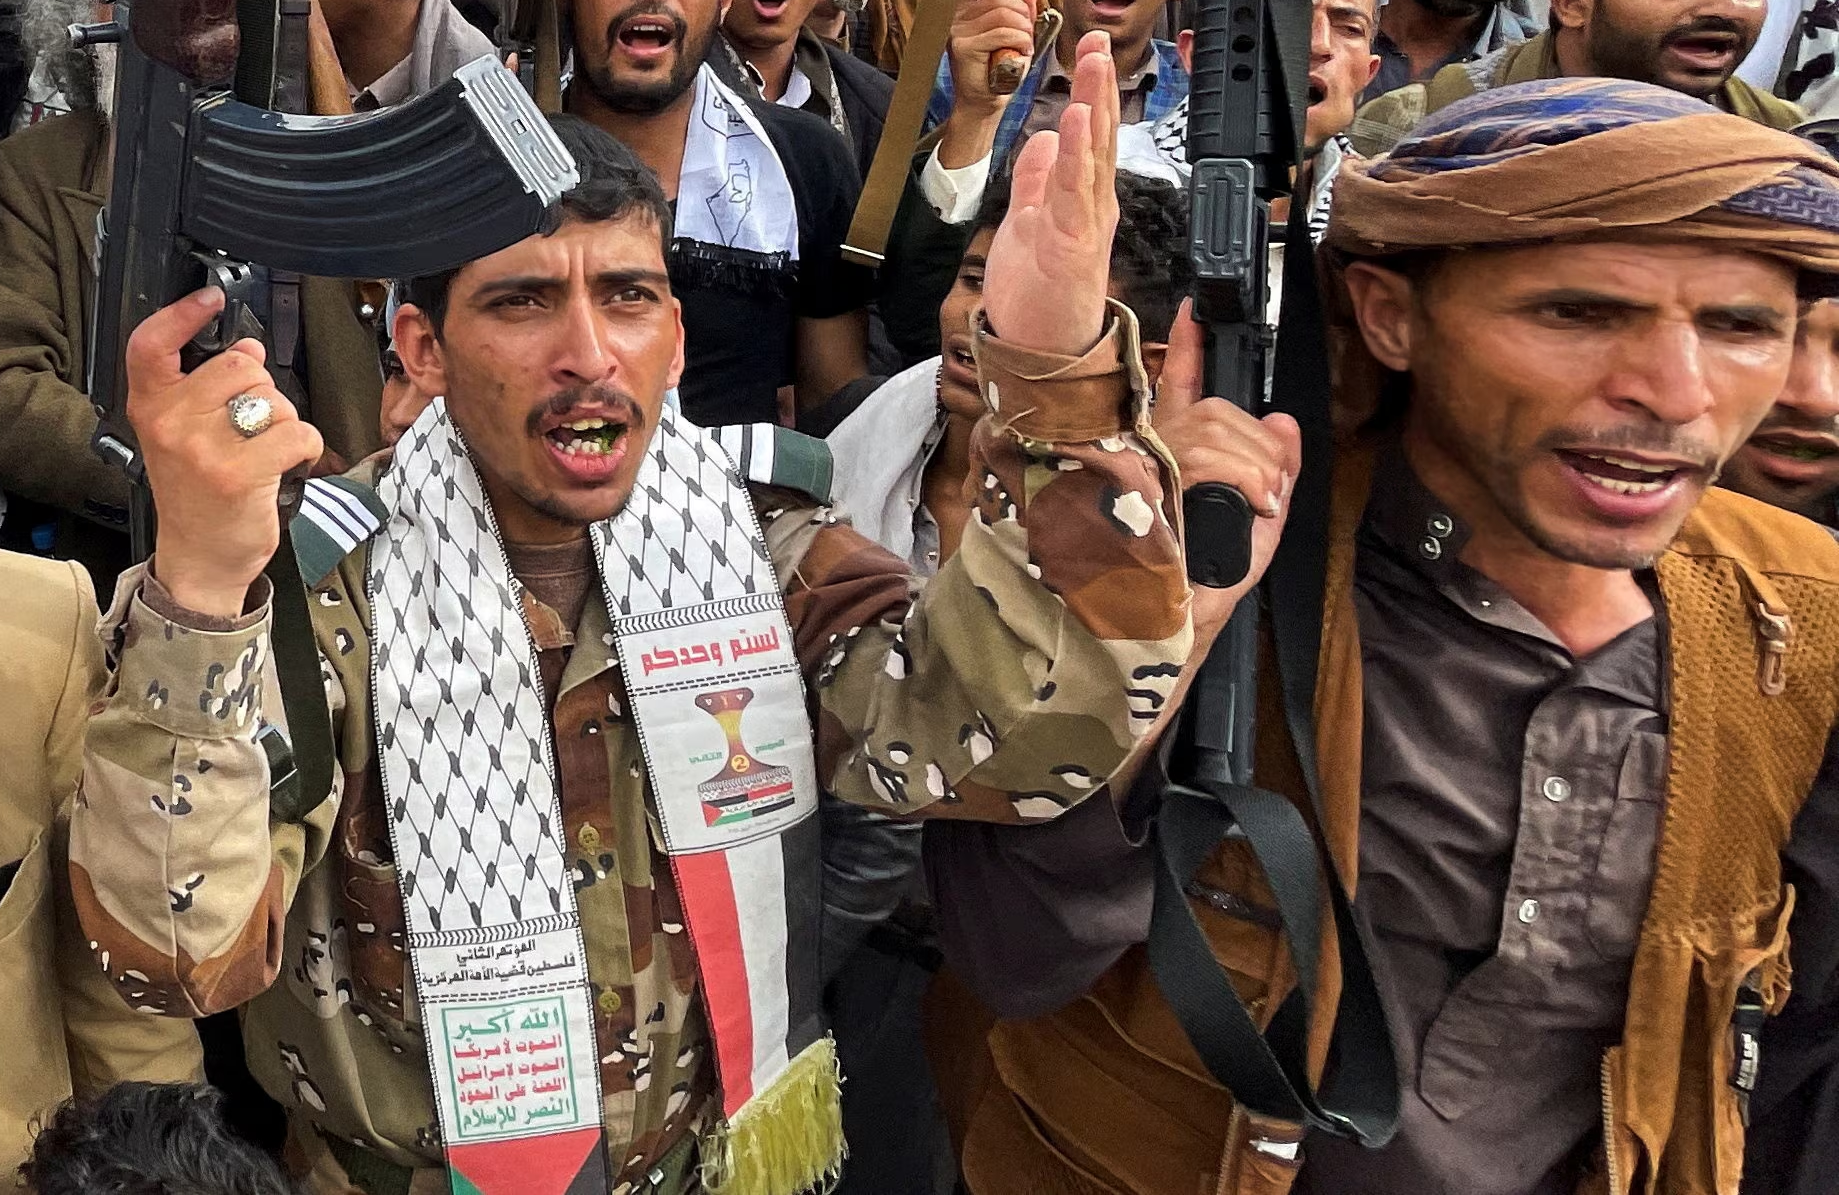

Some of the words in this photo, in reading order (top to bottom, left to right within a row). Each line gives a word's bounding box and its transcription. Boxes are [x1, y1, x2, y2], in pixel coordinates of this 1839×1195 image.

[730, 625, 780, 662] لستم
[640, 641, 724, 677] وحدكم
[734, 757, 747, 770] 2
[456, 946, 494, 967] الثاني
[495, 939, 536, 960] المؤتمر
[469, 966, 494, 981] الأمة
[495, 960, 526, 982] قضية
[526, 953, 576, 976] فلسطين
[422, 969, 469, 987] المركزية
[452, 1007, 514, 1042] أكبر
[520, 1006, 560, 1029] الله
[454, 1036, 512, 1060] لأمريكا
[516, 1033, 562, 1054] الموت
[518, 1056, 565, 1076] الموت
[459, 1085, 500, 1105] اليهود
[505, 1082, 526, 1101] على
[532, 1077, 567, 1094] اللعنة
[463, 1105, 517, 1131] للإسلام
[525, 1096, 571, 1124] النصر
